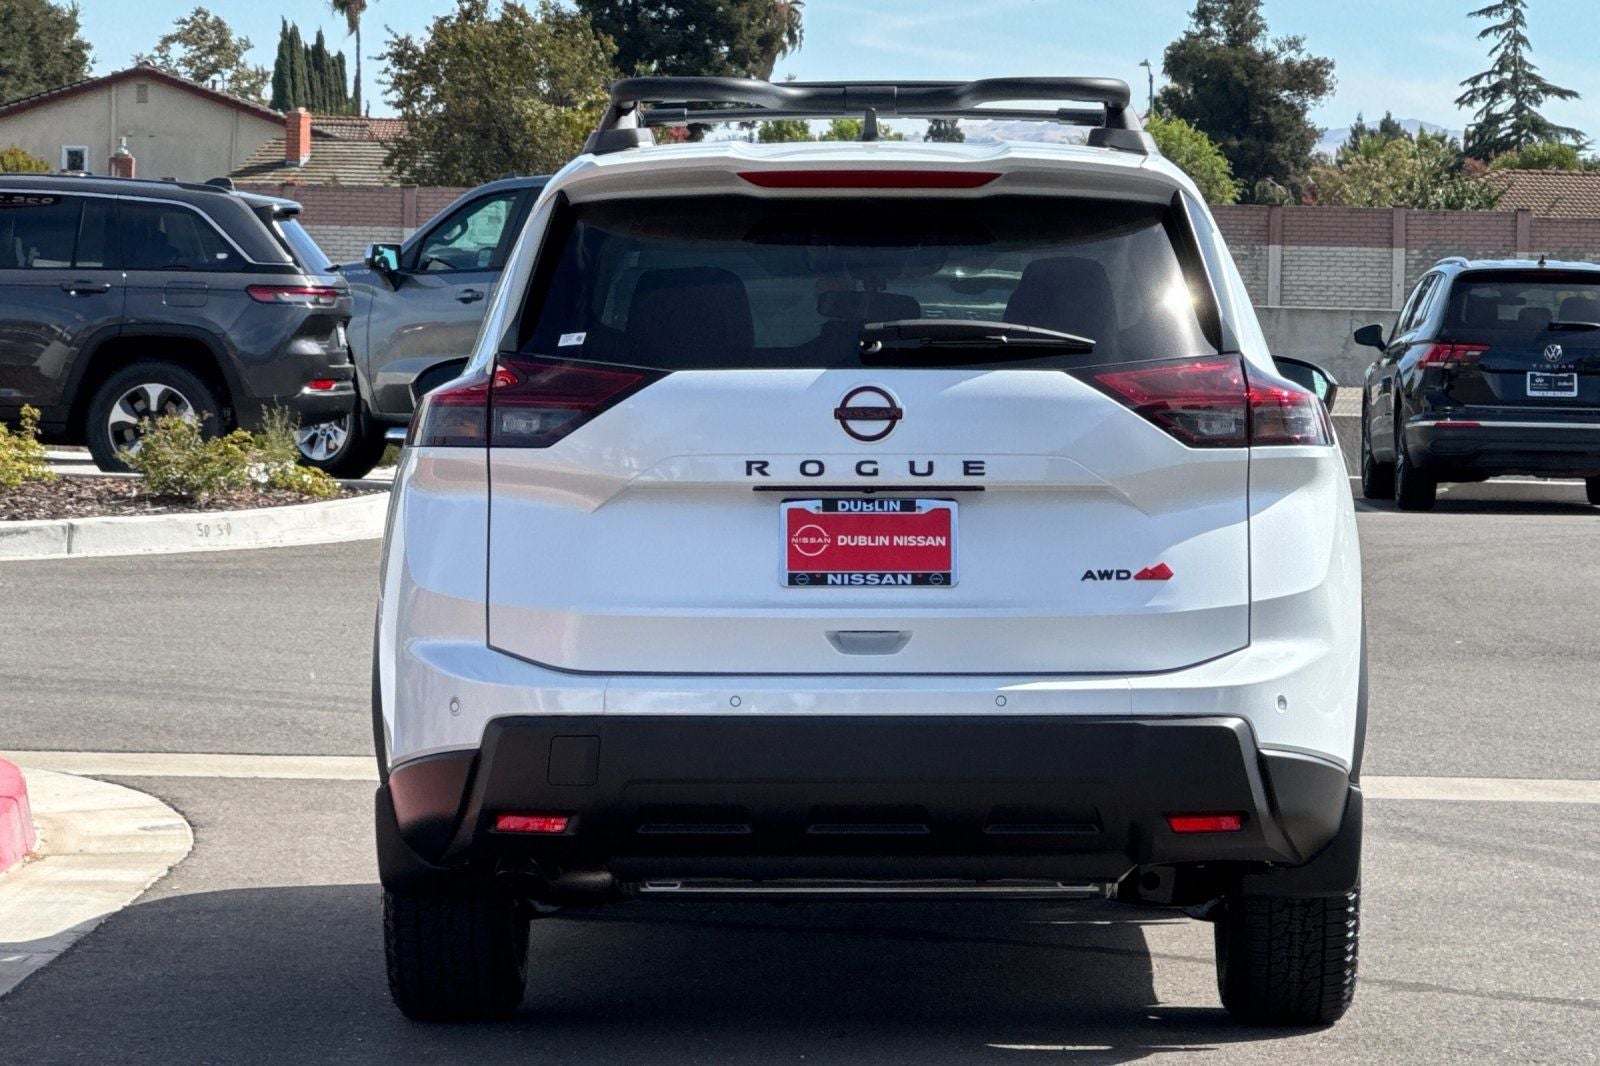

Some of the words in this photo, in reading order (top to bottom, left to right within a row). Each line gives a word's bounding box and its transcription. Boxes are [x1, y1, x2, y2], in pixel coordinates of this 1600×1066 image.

[836, 409, 901, 418] NISSAN
[746, 460, 986, 476] ROGUE
[838, 501, 900, 512] DUBLIN
[837, 535, 889, 546] DUBLIN
[893, 536, 946, 546] NISSAN
[827, 573, 912, 585] NISSAN
[1081, 570, 1131, 580] AWD
